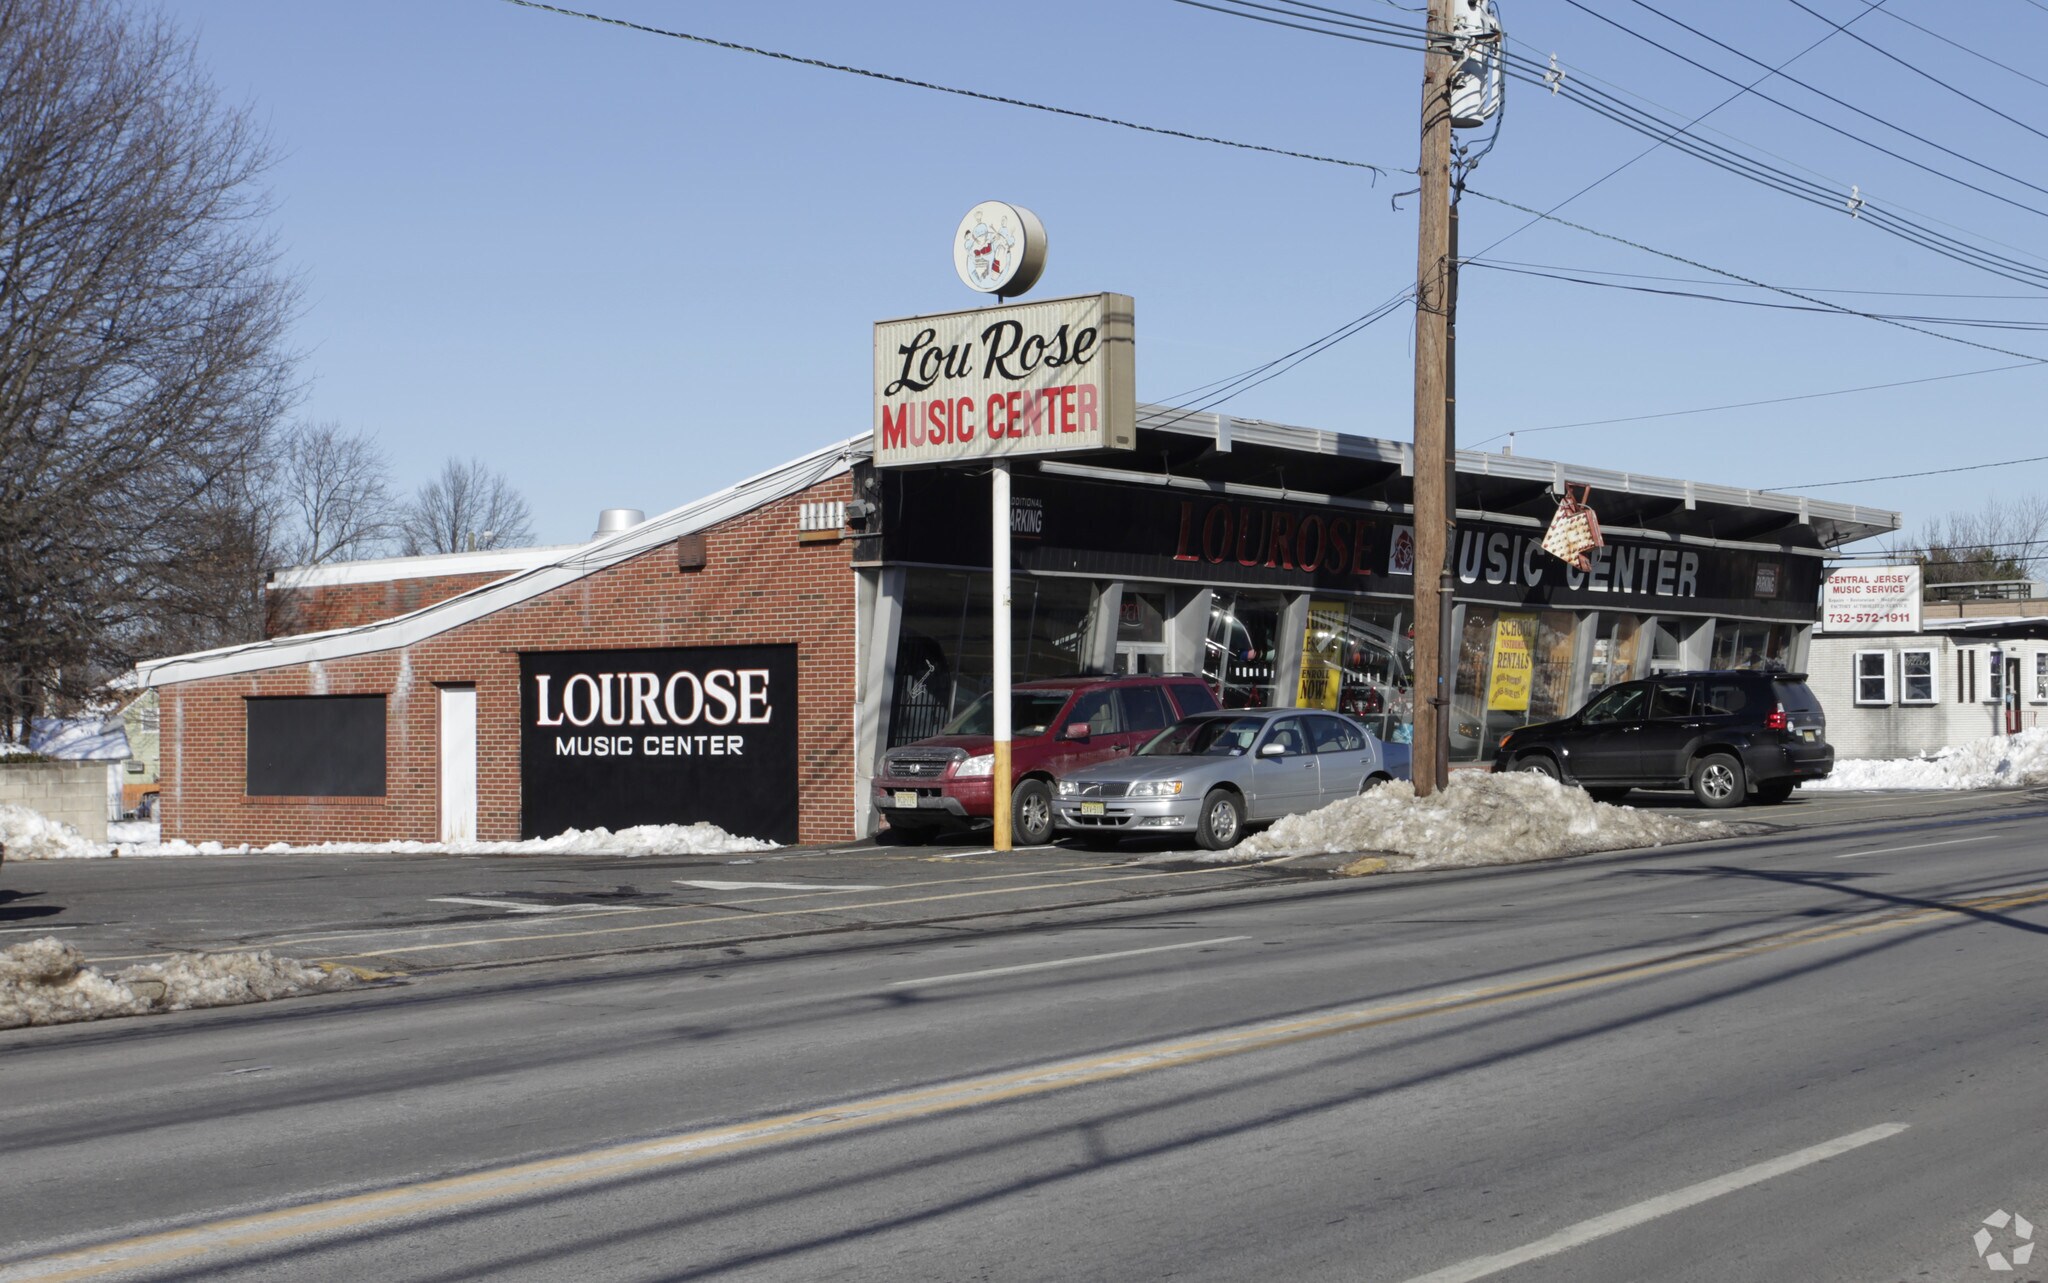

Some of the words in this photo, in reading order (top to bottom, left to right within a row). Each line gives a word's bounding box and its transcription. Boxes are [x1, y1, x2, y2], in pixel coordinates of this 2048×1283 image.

[884, 328, 972, 397] Lou
[981, 319, 1097, 380] Rose
[882, 396, 975, 451] MUSIC
[987, 383, 1098, 440] CENTER
[1010, 496, 1043, 508] DDITIONAL
[1010, 508, 1043, 533] ARKING
[1172, 501, 1376, 576] LOUROSE
[1453, 530, 1545, 588] USIC
[1828, 575, 1869, 584] CENTRAL
[1873, 575, 1910, 584] JERSEY
[1832, 585, 1861, 594] MUSIC
[1866, 585, 1905, 594] SERVICE
[1500, 619, 1532, 637] SCHOOL
[1828, 613, 1910, 623] 732-572-1911
[1497, 652, 1530, 669] RENTALS
[1302, 669, 1330, 679] ENROLL
[535, 669, 772, 727] LOUROSE
[556, 735, 633, 757] MUSIC
[644, 734, 744, 756] CENTER
